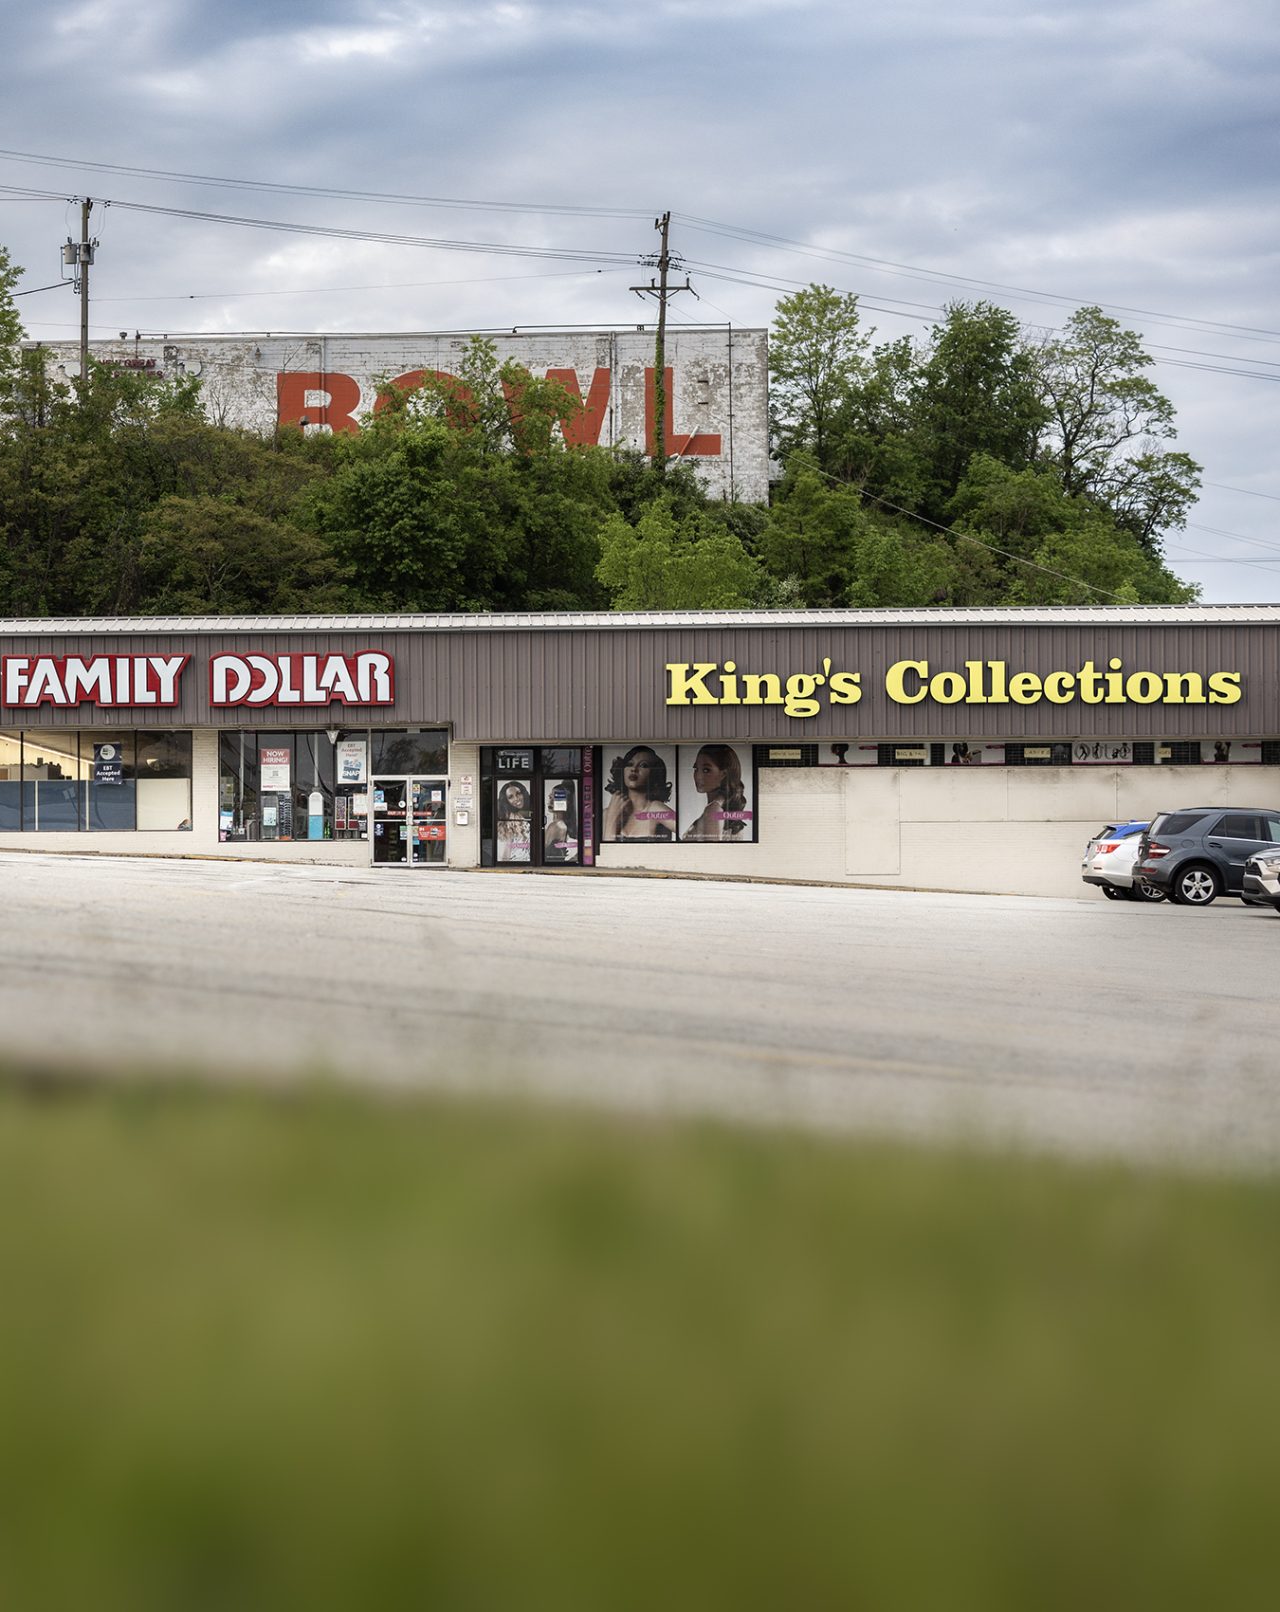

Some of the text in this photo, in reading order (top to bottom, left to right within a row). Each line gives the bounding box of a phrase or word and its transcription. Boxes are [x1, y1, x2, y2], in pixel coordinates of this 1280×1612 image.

[6, 653, 391, 704] FAMILY DOLLAR
[666, 657, 1242, 718] King's Collections
[498, 758, 529, 769] LIFE
